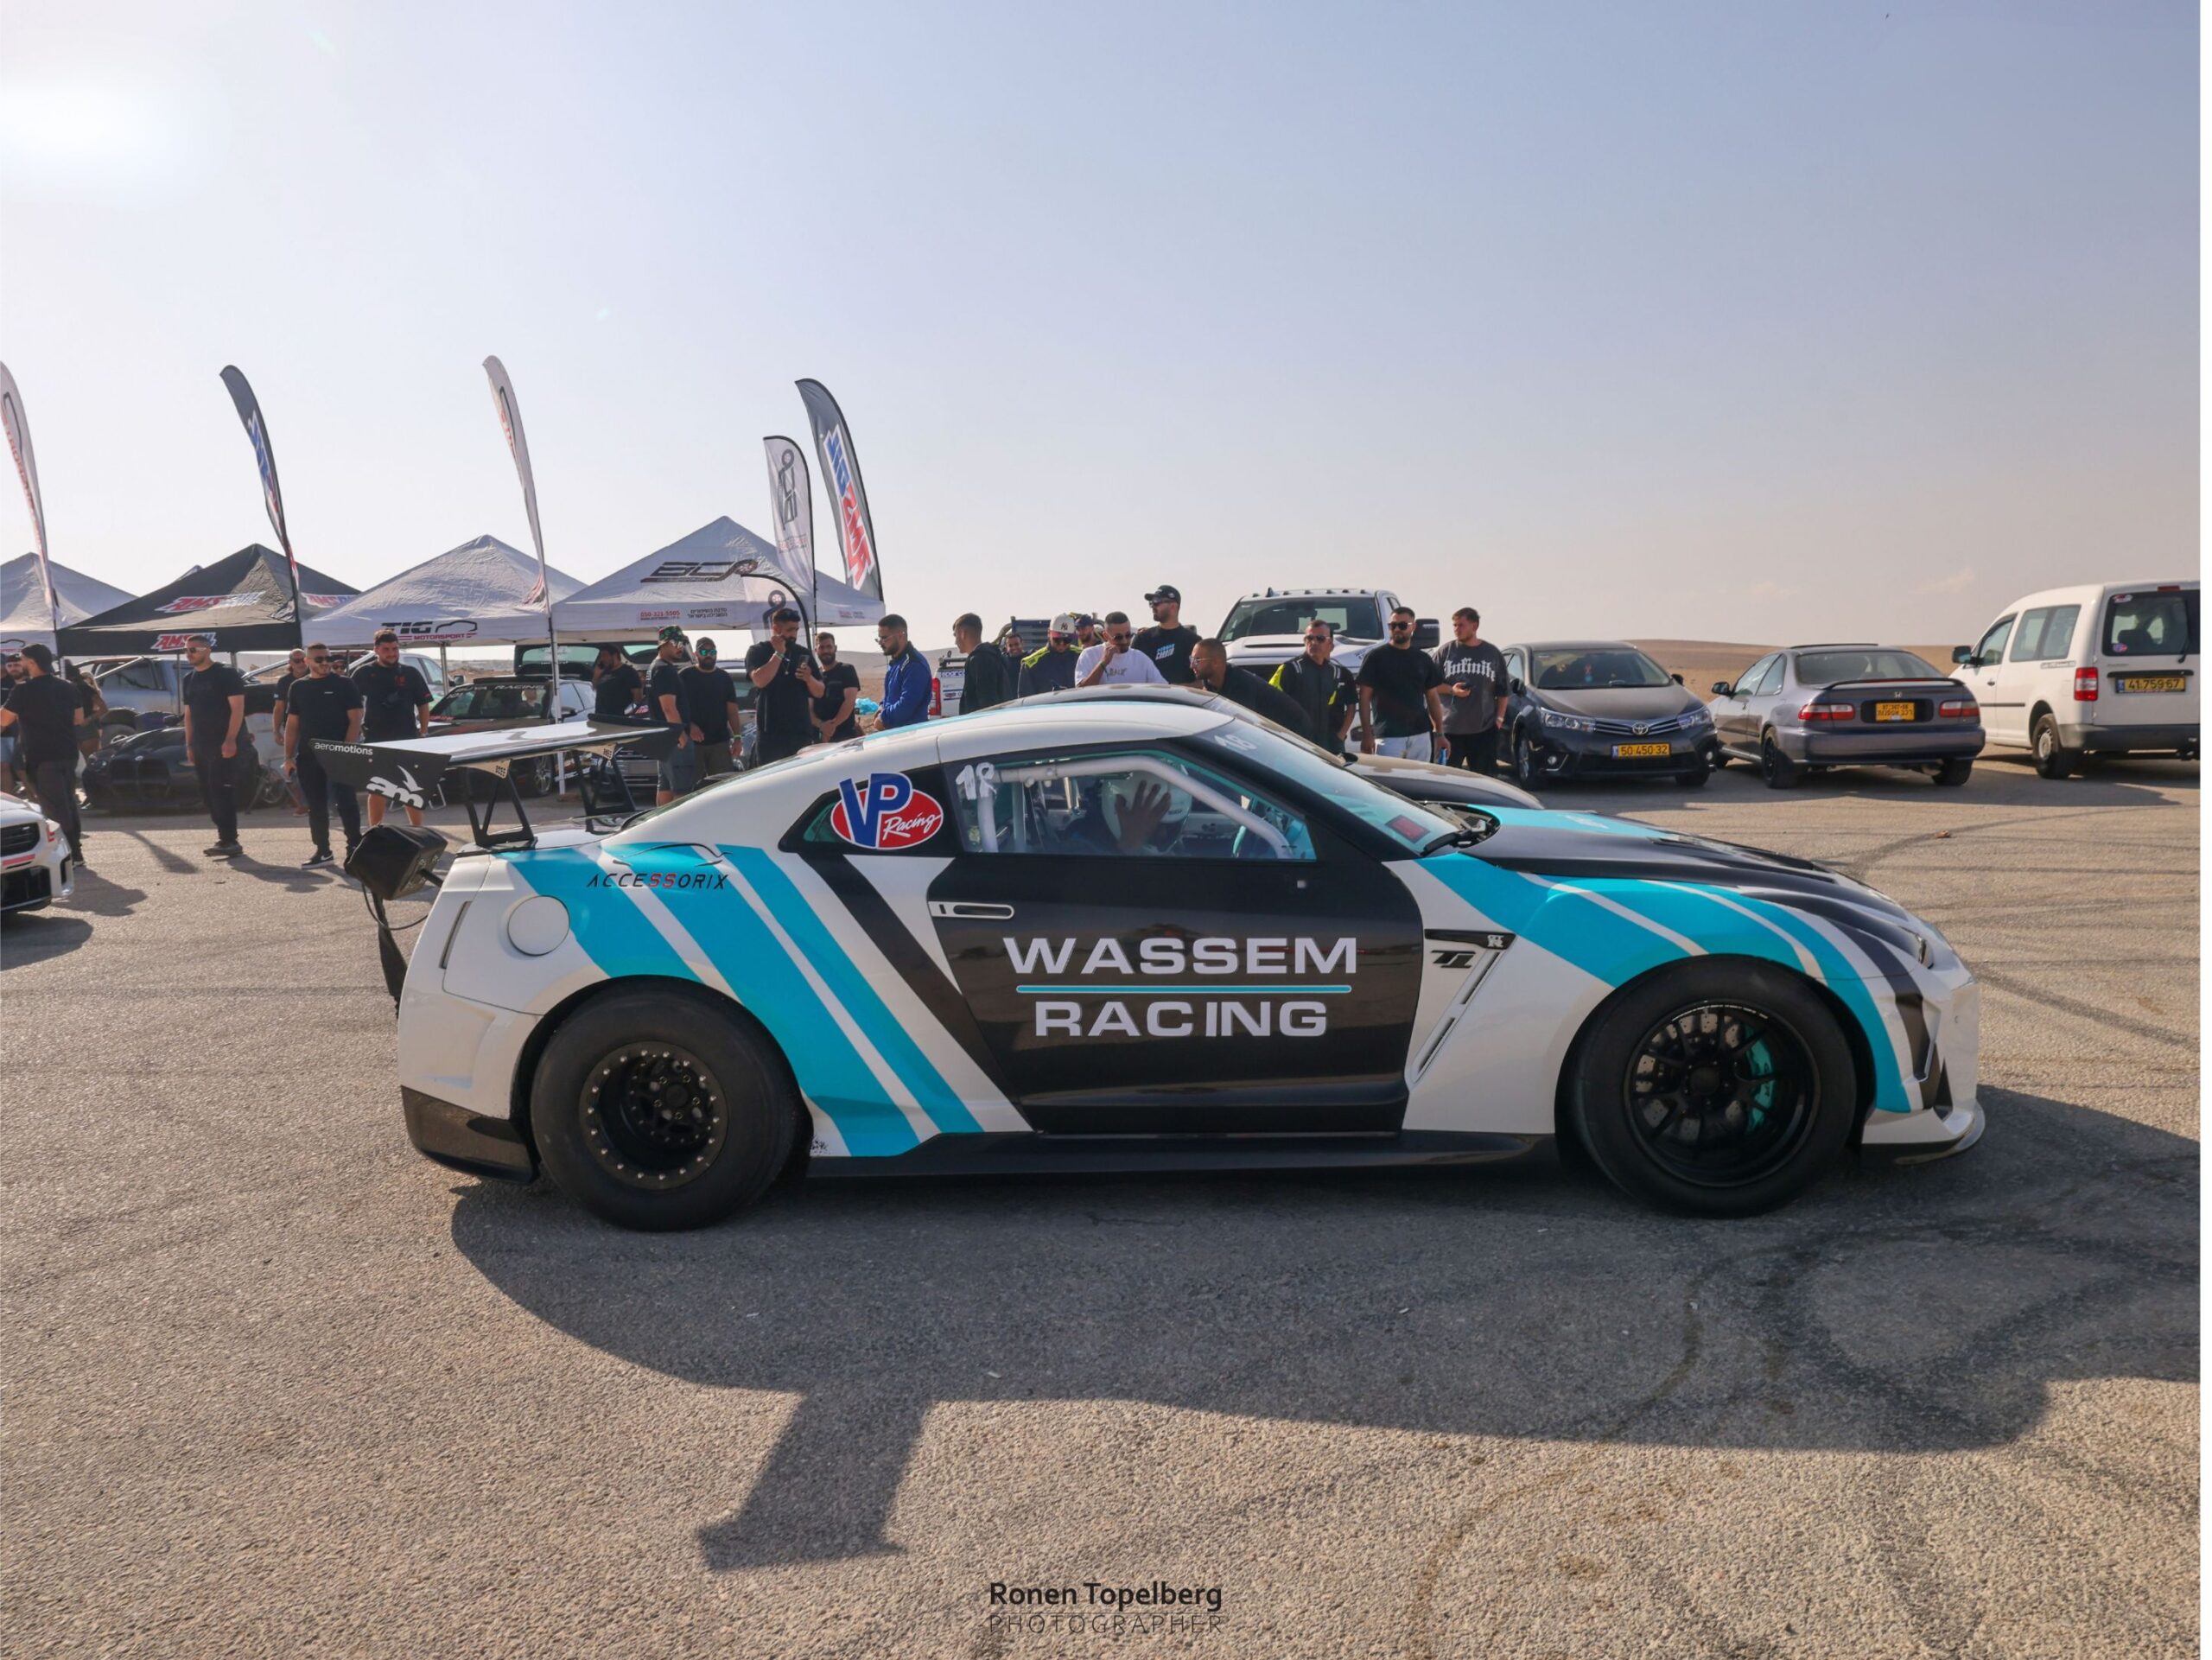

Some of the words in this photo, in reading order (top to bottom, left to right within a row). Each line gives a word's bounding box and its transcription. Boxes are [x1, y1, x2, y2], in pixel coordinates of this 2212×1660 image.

[314, 741, 373, 756] aeromotions
[838, 773, 912, 849] VP
[883, 812, 942, 841] Racing
[587, 873, 728, 889] ACCESSORIX
[1002, 937, 1357, 975] WASSEM
[1034, 1001, 1327, 1037] RACING
